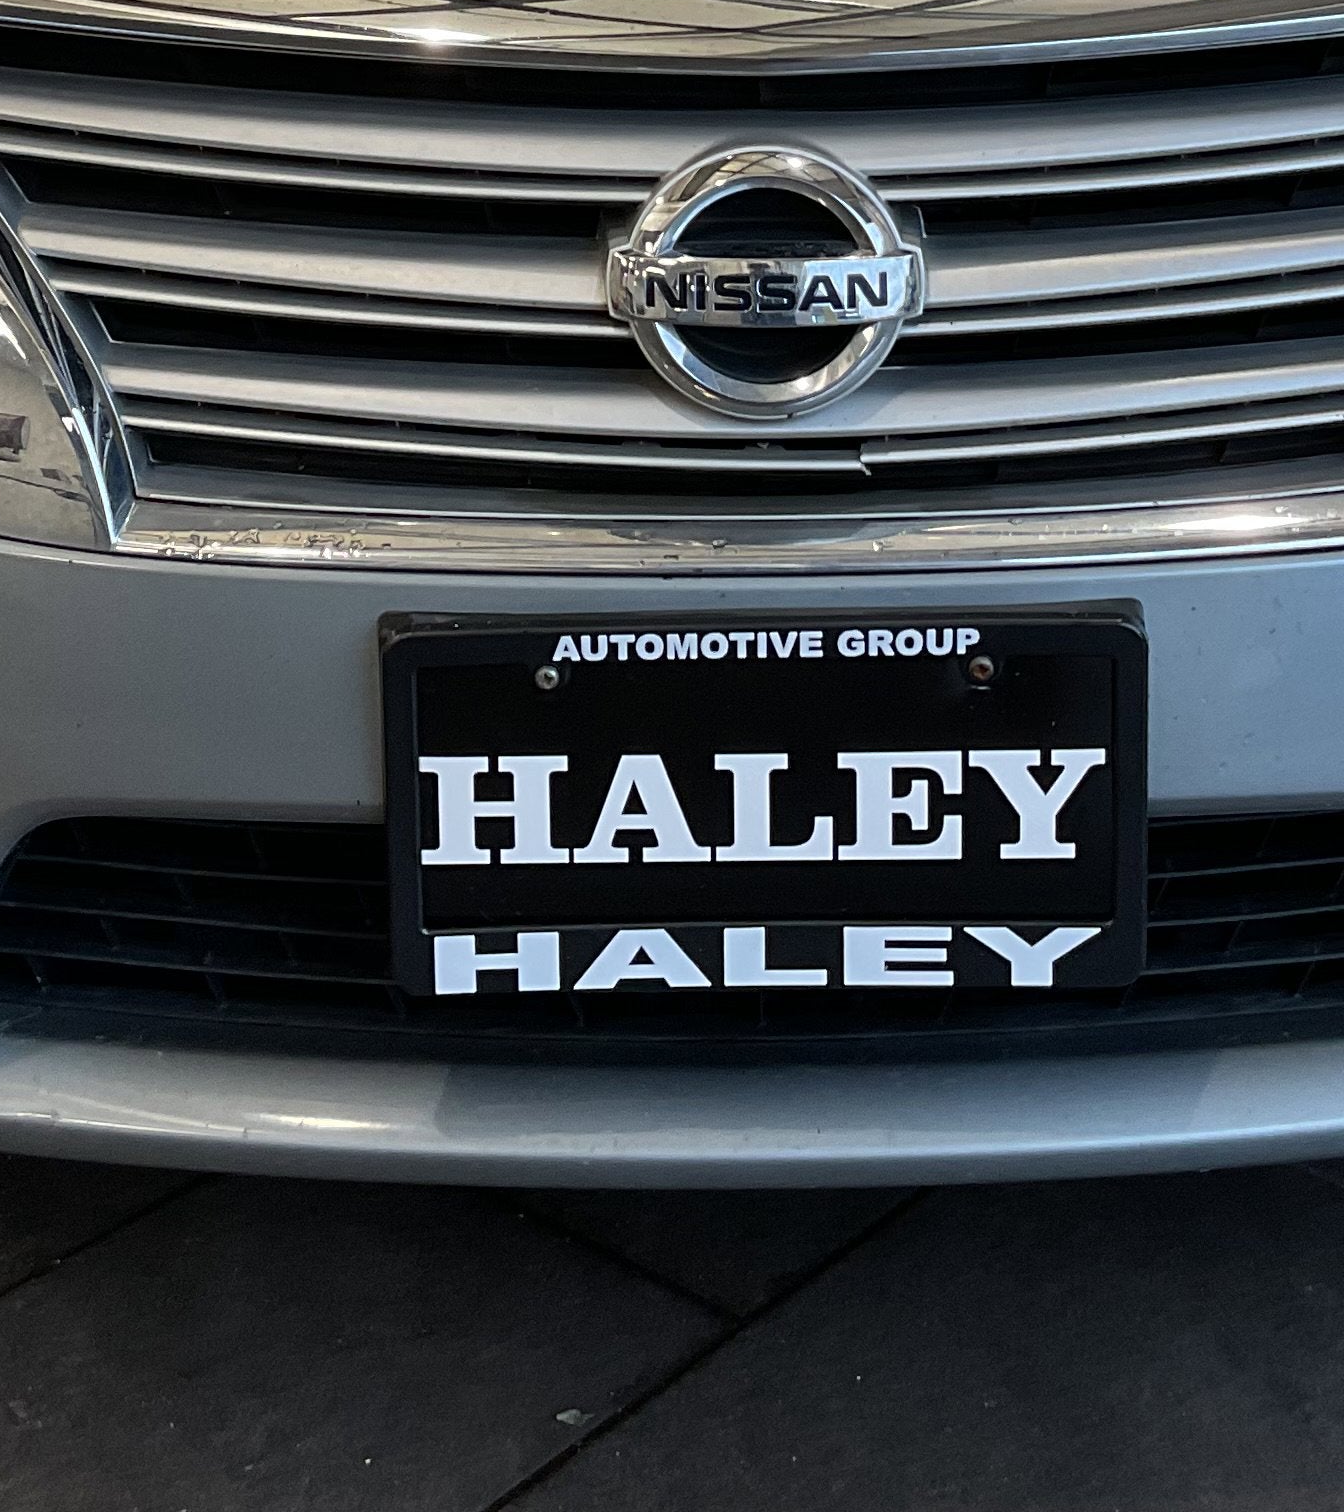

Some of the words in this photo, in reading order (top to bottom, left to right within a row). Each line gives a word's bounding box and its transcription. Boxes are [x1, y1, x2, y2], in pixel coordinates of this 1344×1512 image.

[644, 271, 889, 312] NISSAN
[552, 630, 824, 662] AUTOMOTIVE
[837, 627, 981, 658] GROUP
[418, 747, 1106, 866] HALEY
[433, 926, 1102, 995] HALEY
